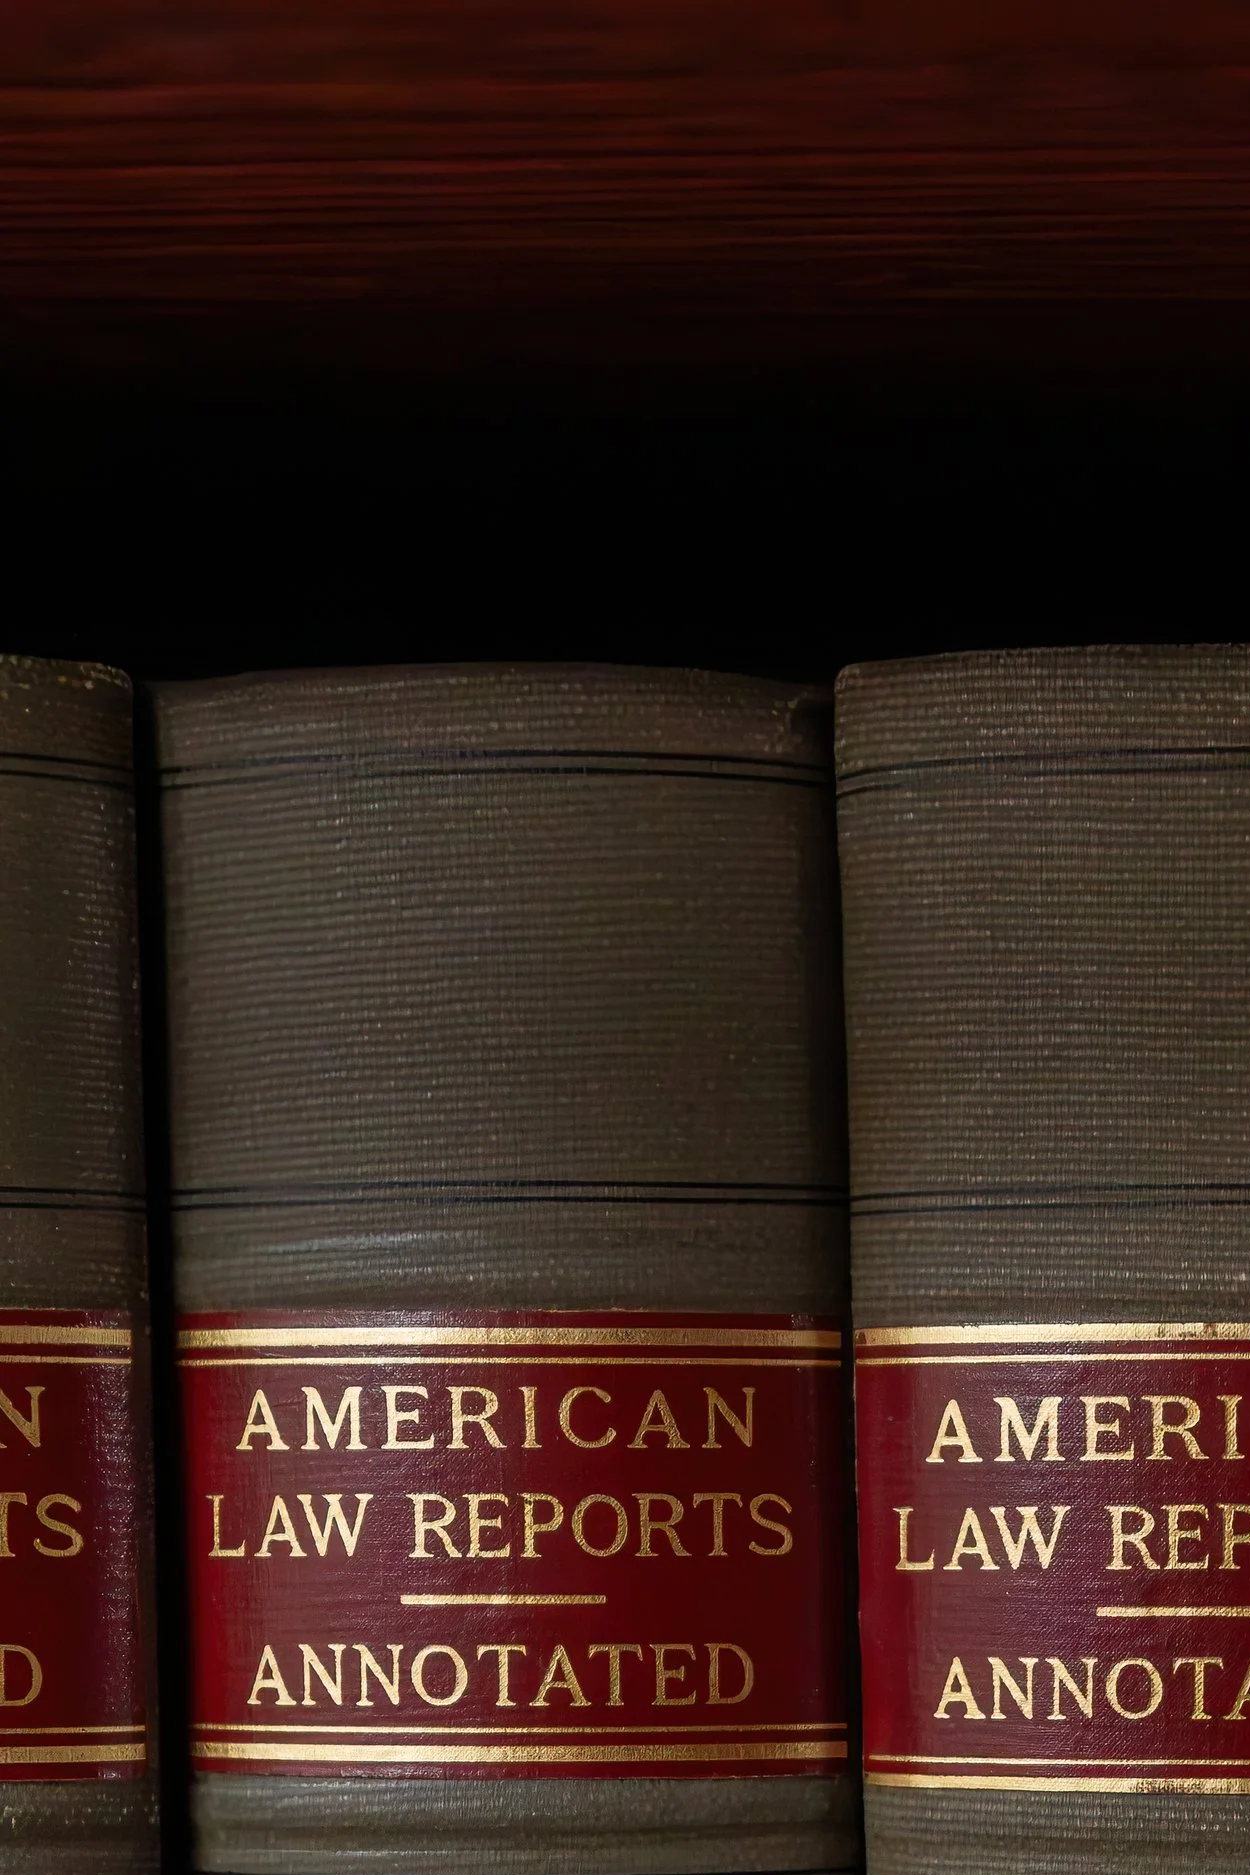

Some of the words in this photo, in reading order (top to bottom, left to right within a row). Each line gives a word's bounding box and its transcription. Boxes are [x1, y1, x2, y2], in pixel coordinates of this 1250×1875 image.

[236, 1384, 757, 1451] AMERICAN
[207, 1493, 374, 1559] LAW
[406, 1492, 792, 1560] REPORTS
[894, 1505, 1070, 1571] LAW
[247, 1642, 756, 1708] ANNOTATED
